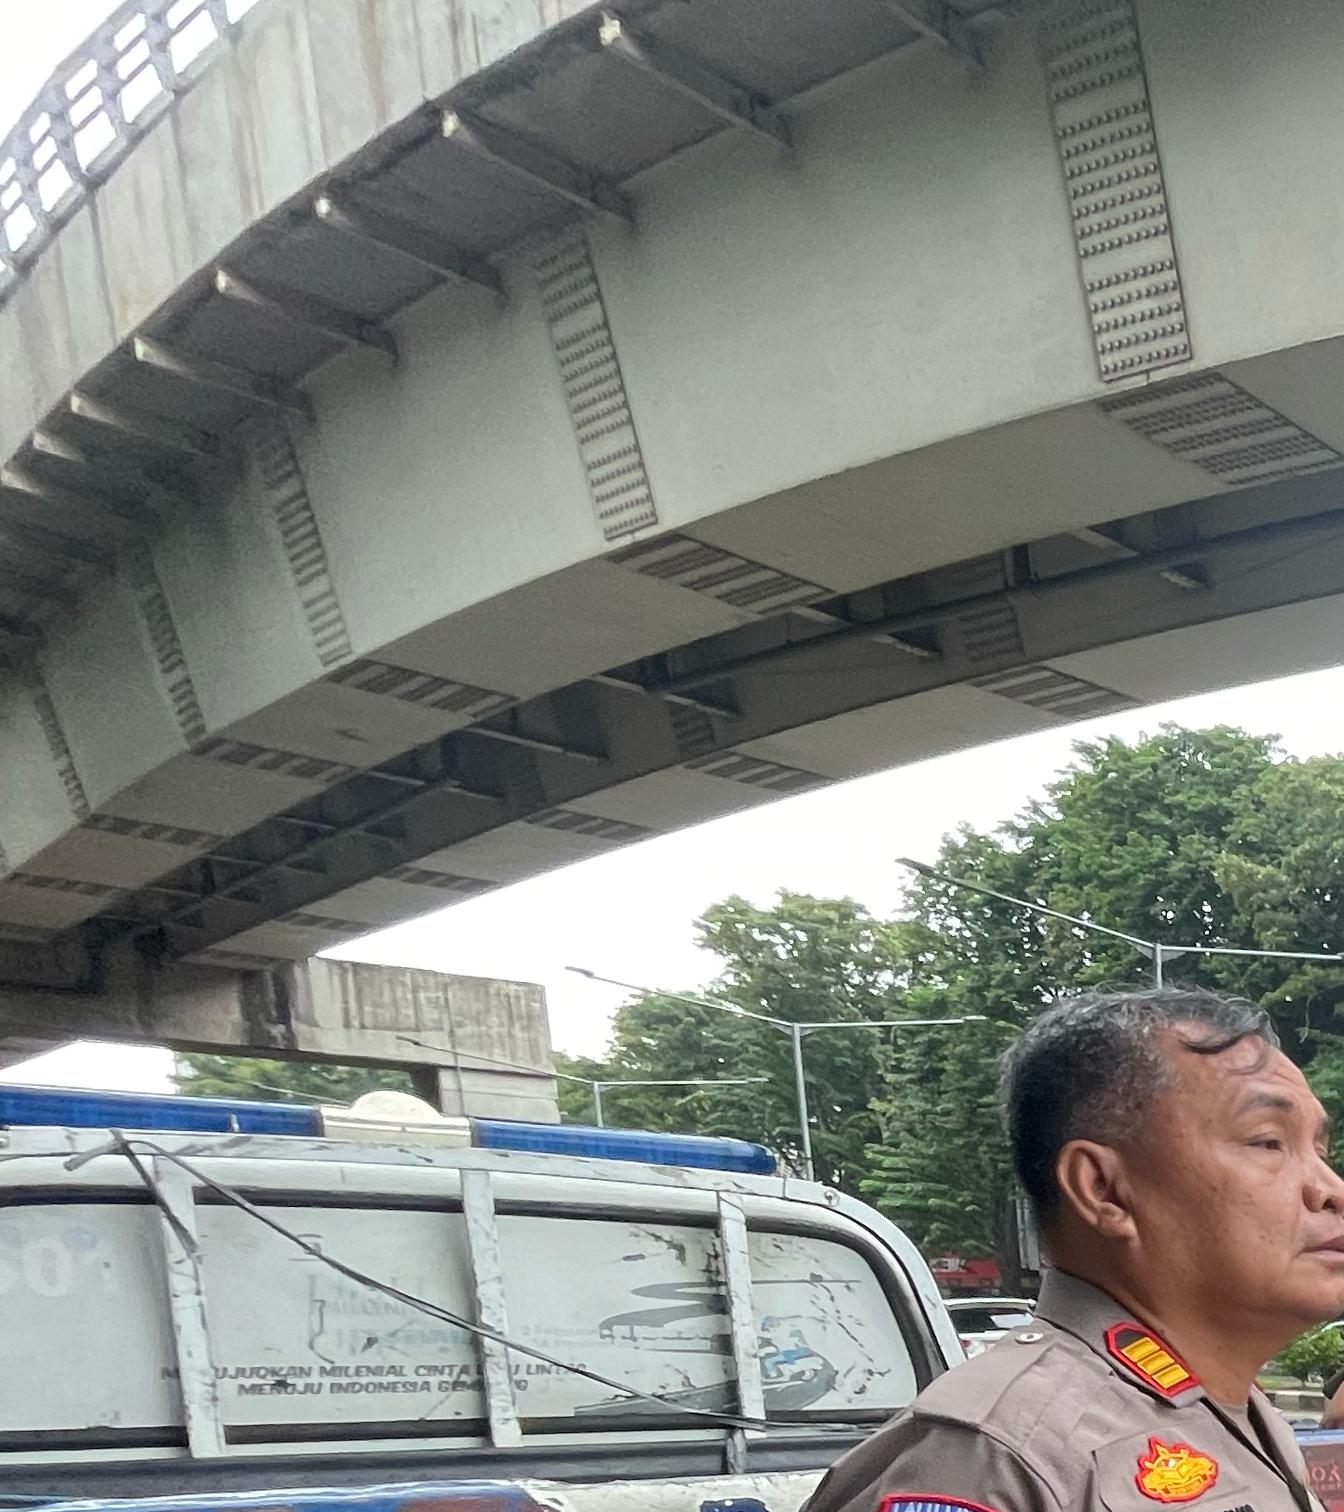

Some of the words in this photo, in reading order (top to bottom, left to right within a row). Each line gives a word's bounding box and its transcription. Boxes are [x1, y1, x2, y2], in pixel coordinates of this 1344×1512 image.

[319, 1364, 407, 1378] MILENIAL
[414, 1364, 471, 1377] CINTA
[238, 1382, 322, 1396] MENUJU
[330, 1381, 431, 1395] INDONESIA
